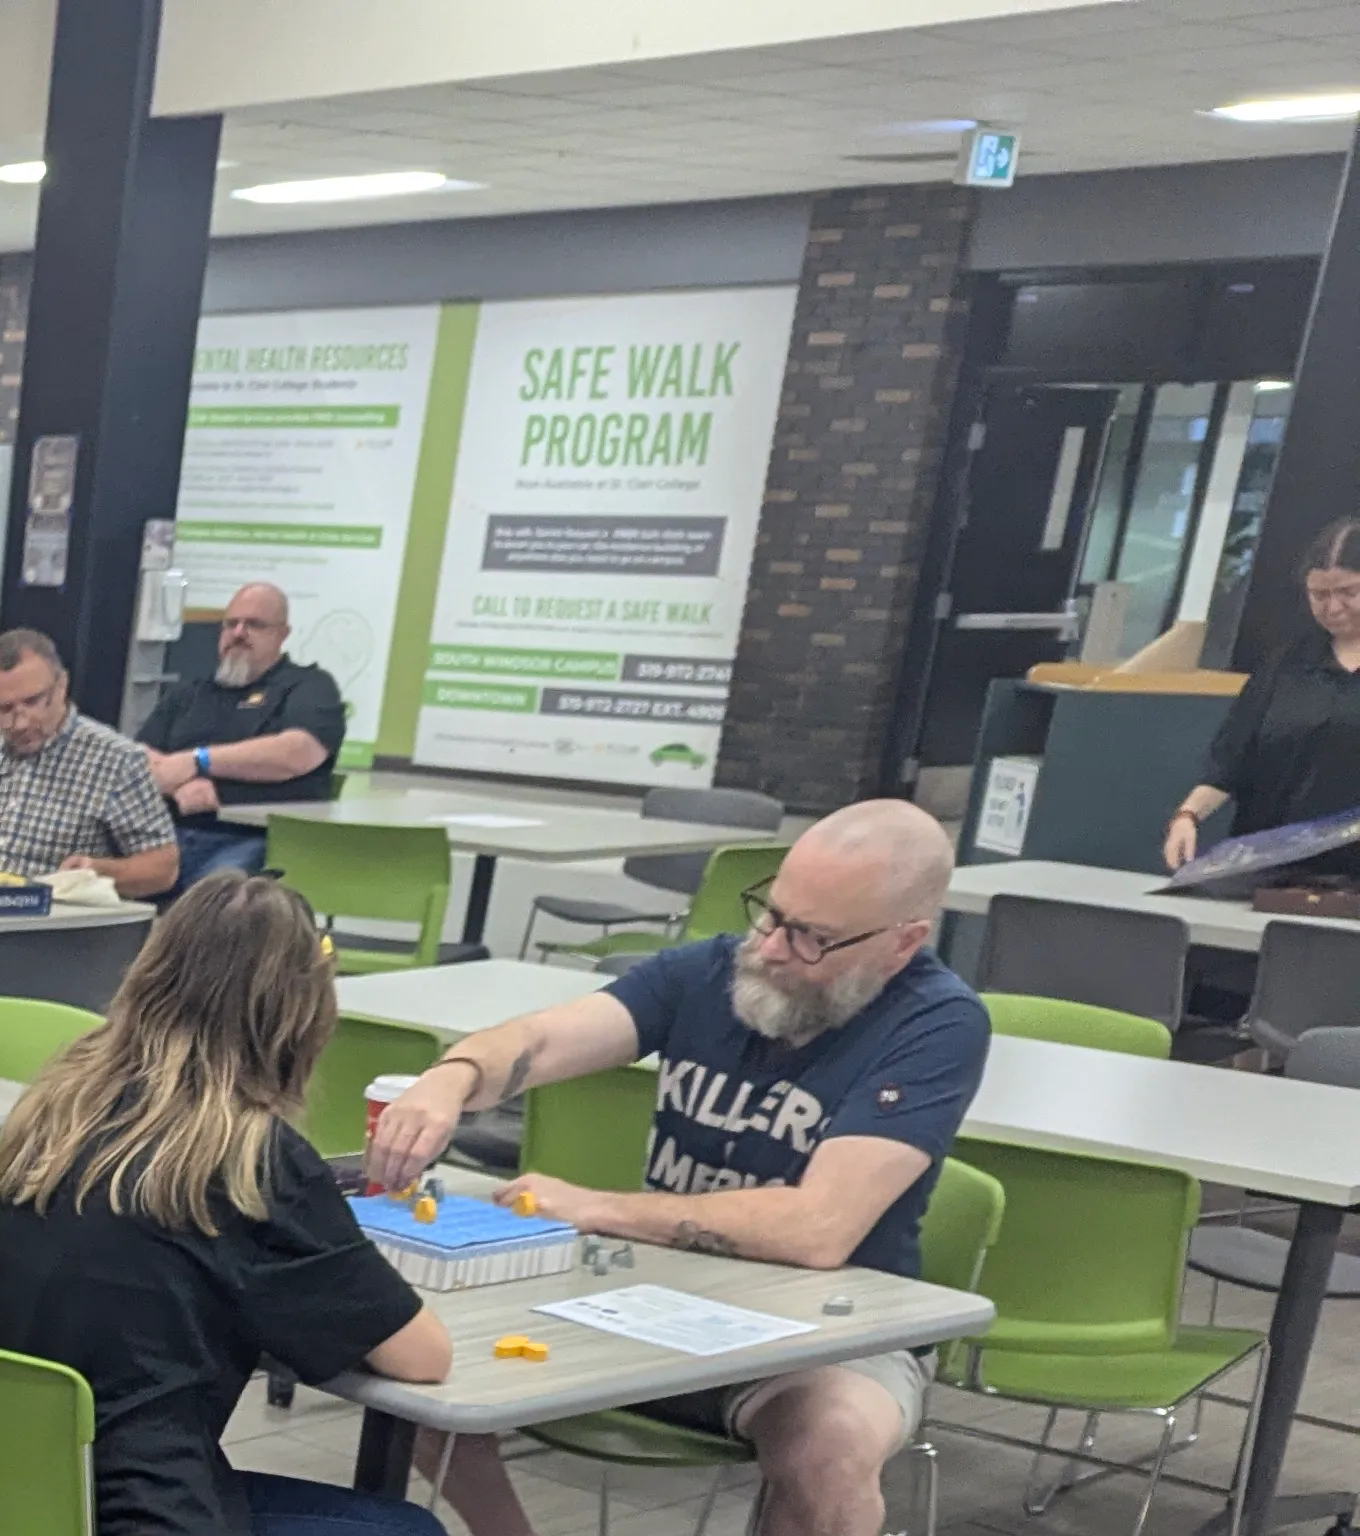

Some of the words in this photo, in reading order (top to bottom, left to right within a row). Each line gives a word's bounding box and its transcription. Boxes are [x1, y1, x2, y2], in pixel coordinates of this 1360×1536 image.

[193, 348, 239, 374] ENTAL
[518, 345, 616, 400] SAFE
[627, 341, 741, 398] WALK
[520, 411, 714, 468] PROGRAM
[656, 1058, 831, 1154] KILLER
